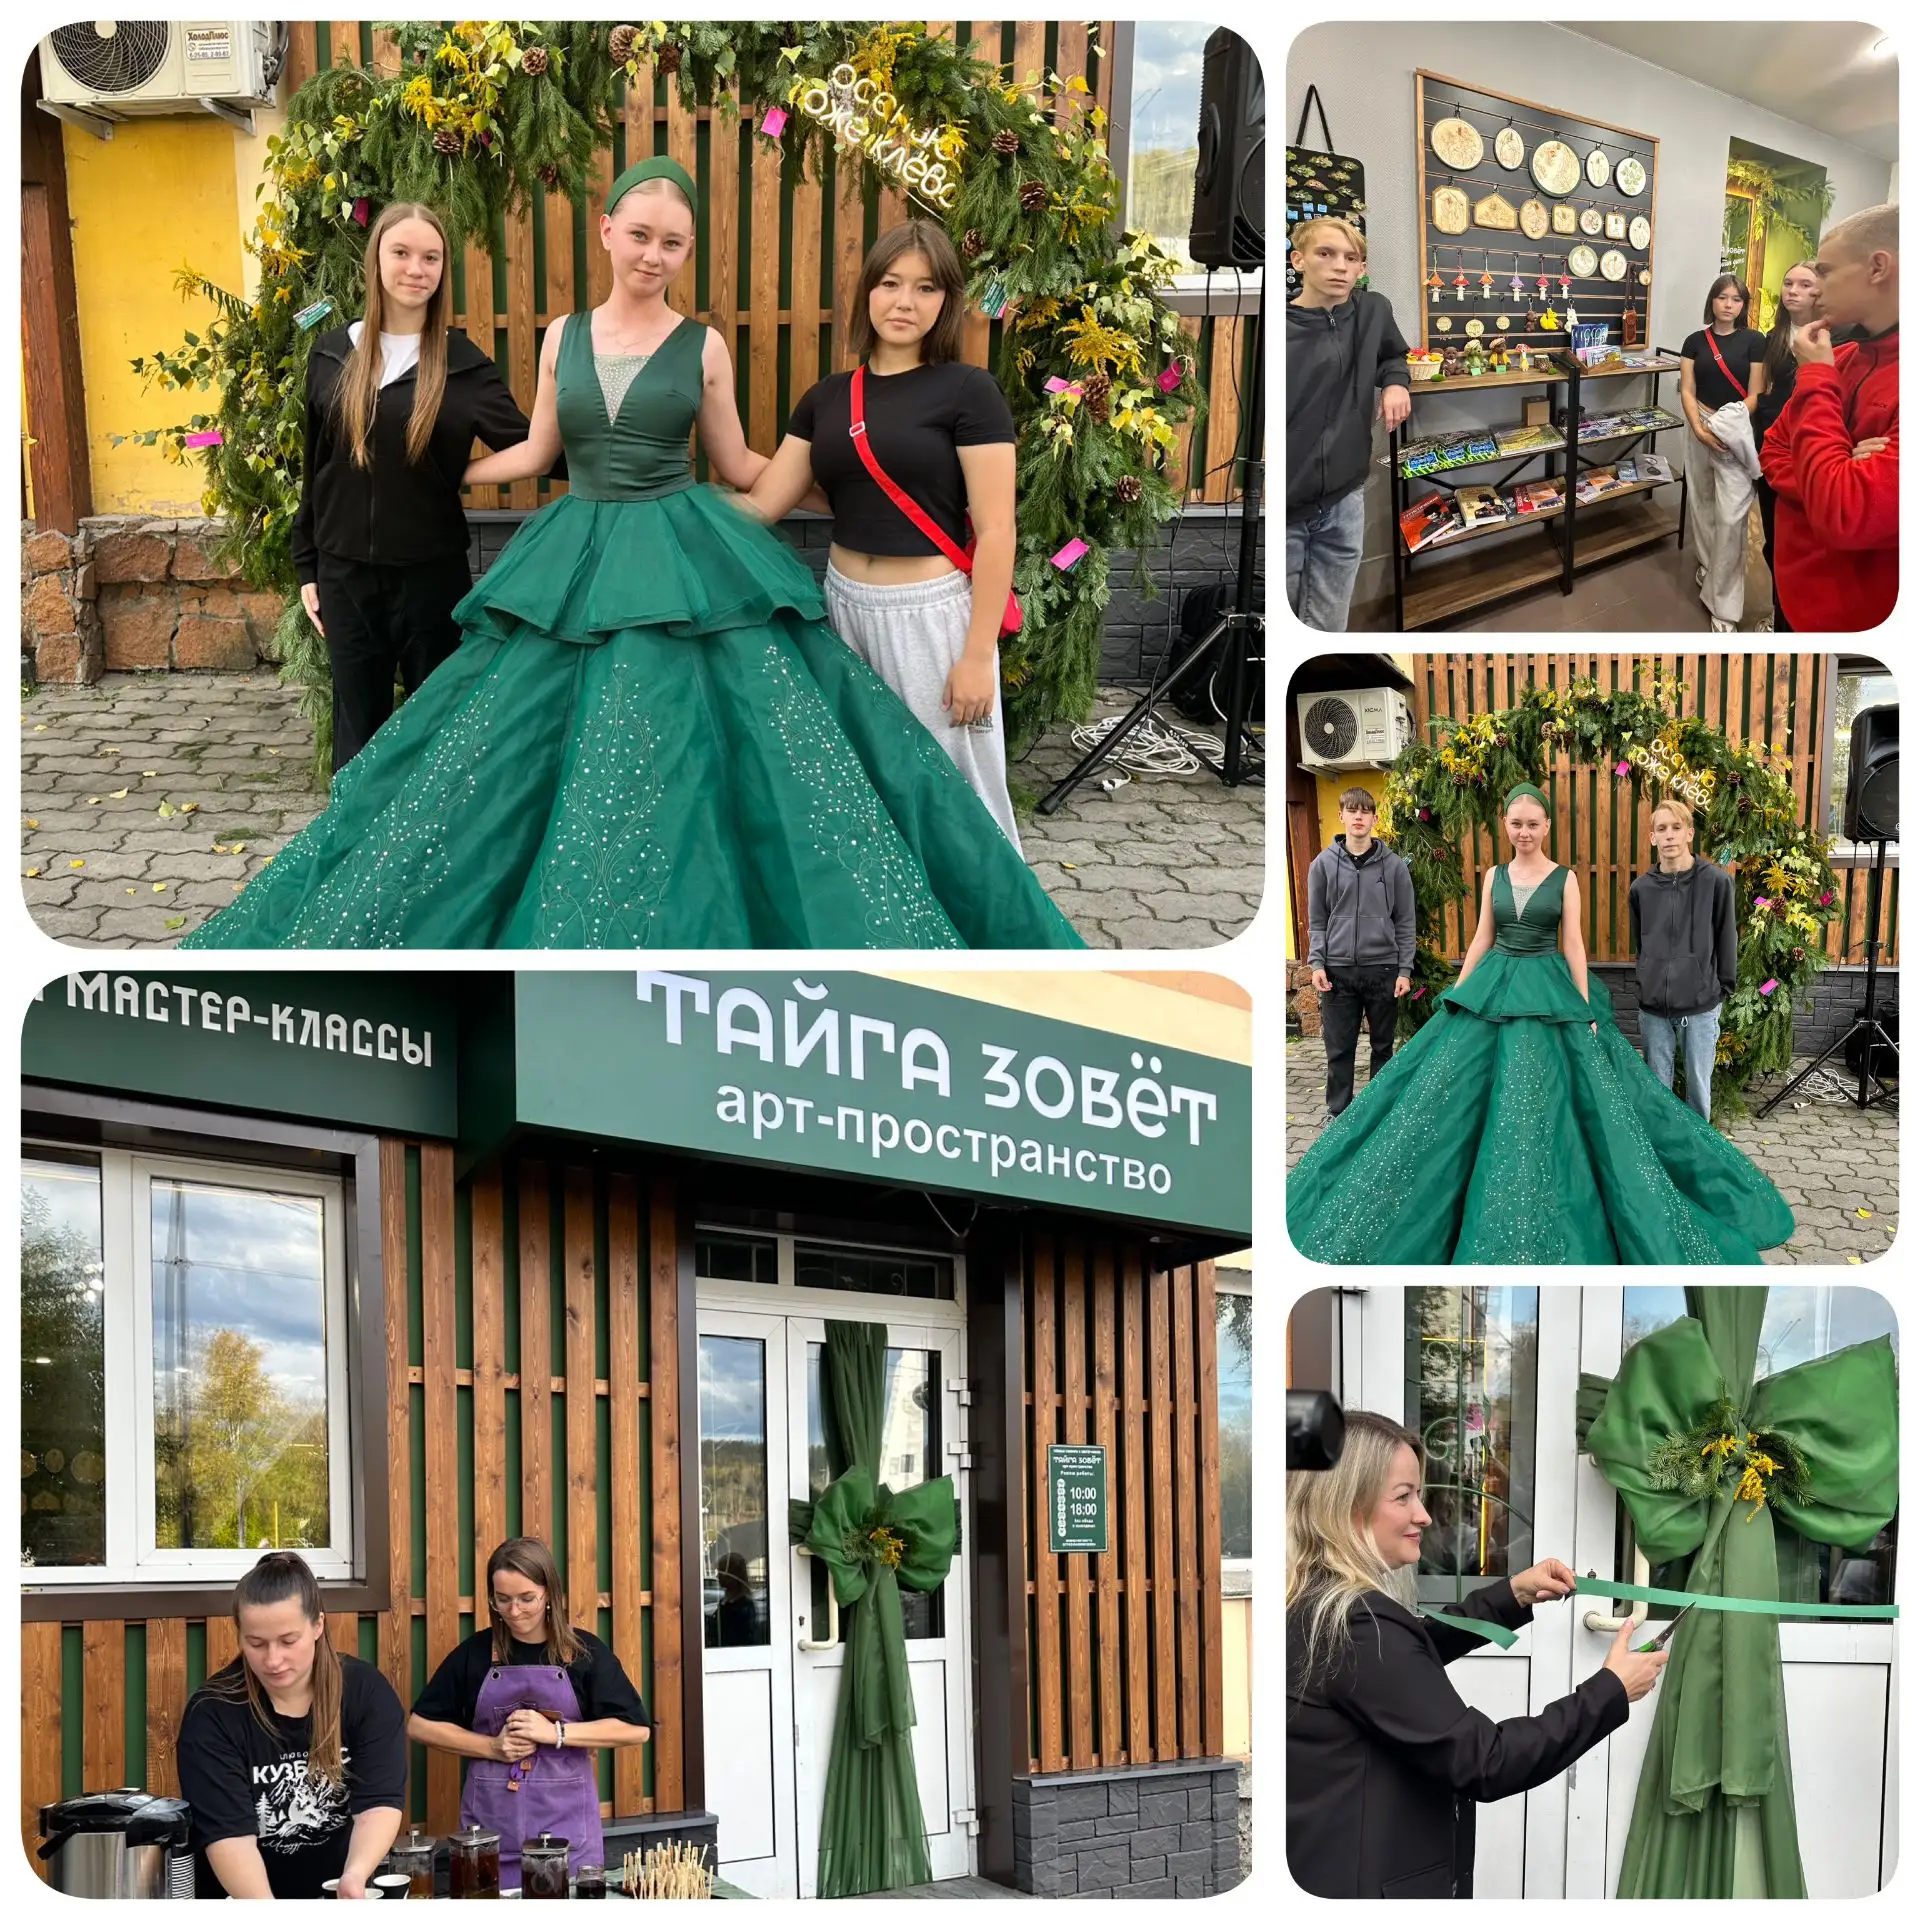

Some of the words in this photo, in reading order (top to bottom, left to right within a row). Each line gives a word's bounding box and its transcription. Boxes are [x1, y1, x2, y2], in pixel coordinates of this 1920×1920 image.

[66, 971, 432, 1067] МАСТЕР-КЛАССЫ
[635, 970, 952, 1098] ТАЙГА
[716, 1084, 1173, 1195] арт-пространство
[1069, 1487, 1097, 1500] 10:00
[1069, 1502, 1097, 1516] 18:00
[252, 1747, 352, 1785] КУЗБС
